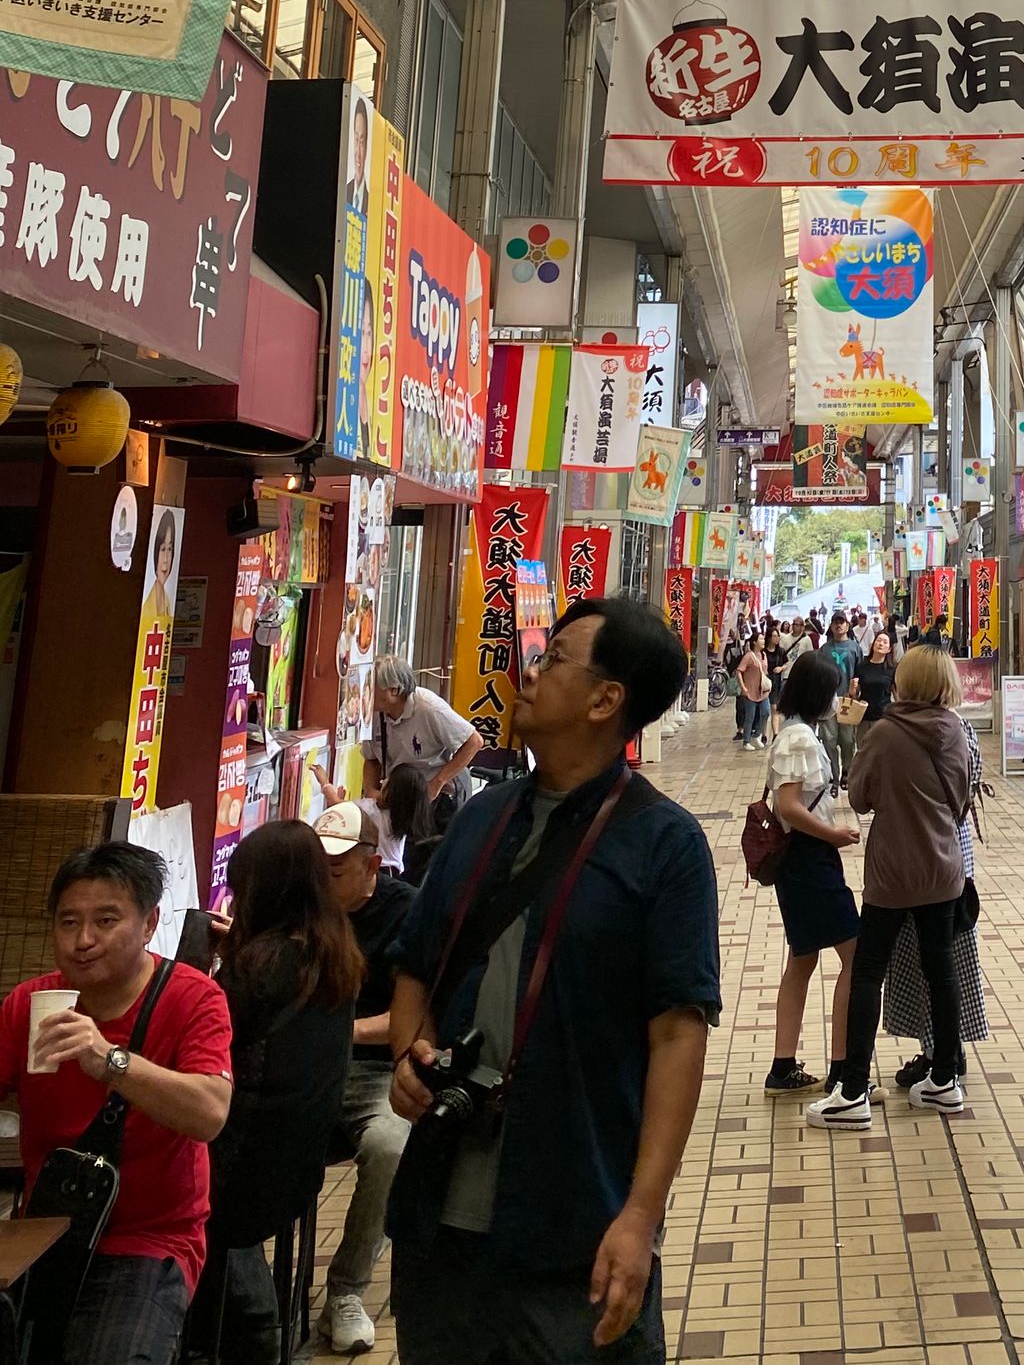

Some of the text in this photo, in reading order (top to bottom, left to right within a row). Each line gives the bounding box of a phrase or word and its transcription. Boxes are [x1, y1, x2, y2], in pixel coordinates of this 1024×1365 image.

[650, 29, 759, 99] 新生
[692, 142, 744, 178] 祝
[811, 217, 887, 236] 認知症に
[847, 266, 916, 300] 大須
[410, 259, 460, 371] Tappy
[642, 364, 664, 424] 大須
[133, 622, 164, 816] 中田ち
